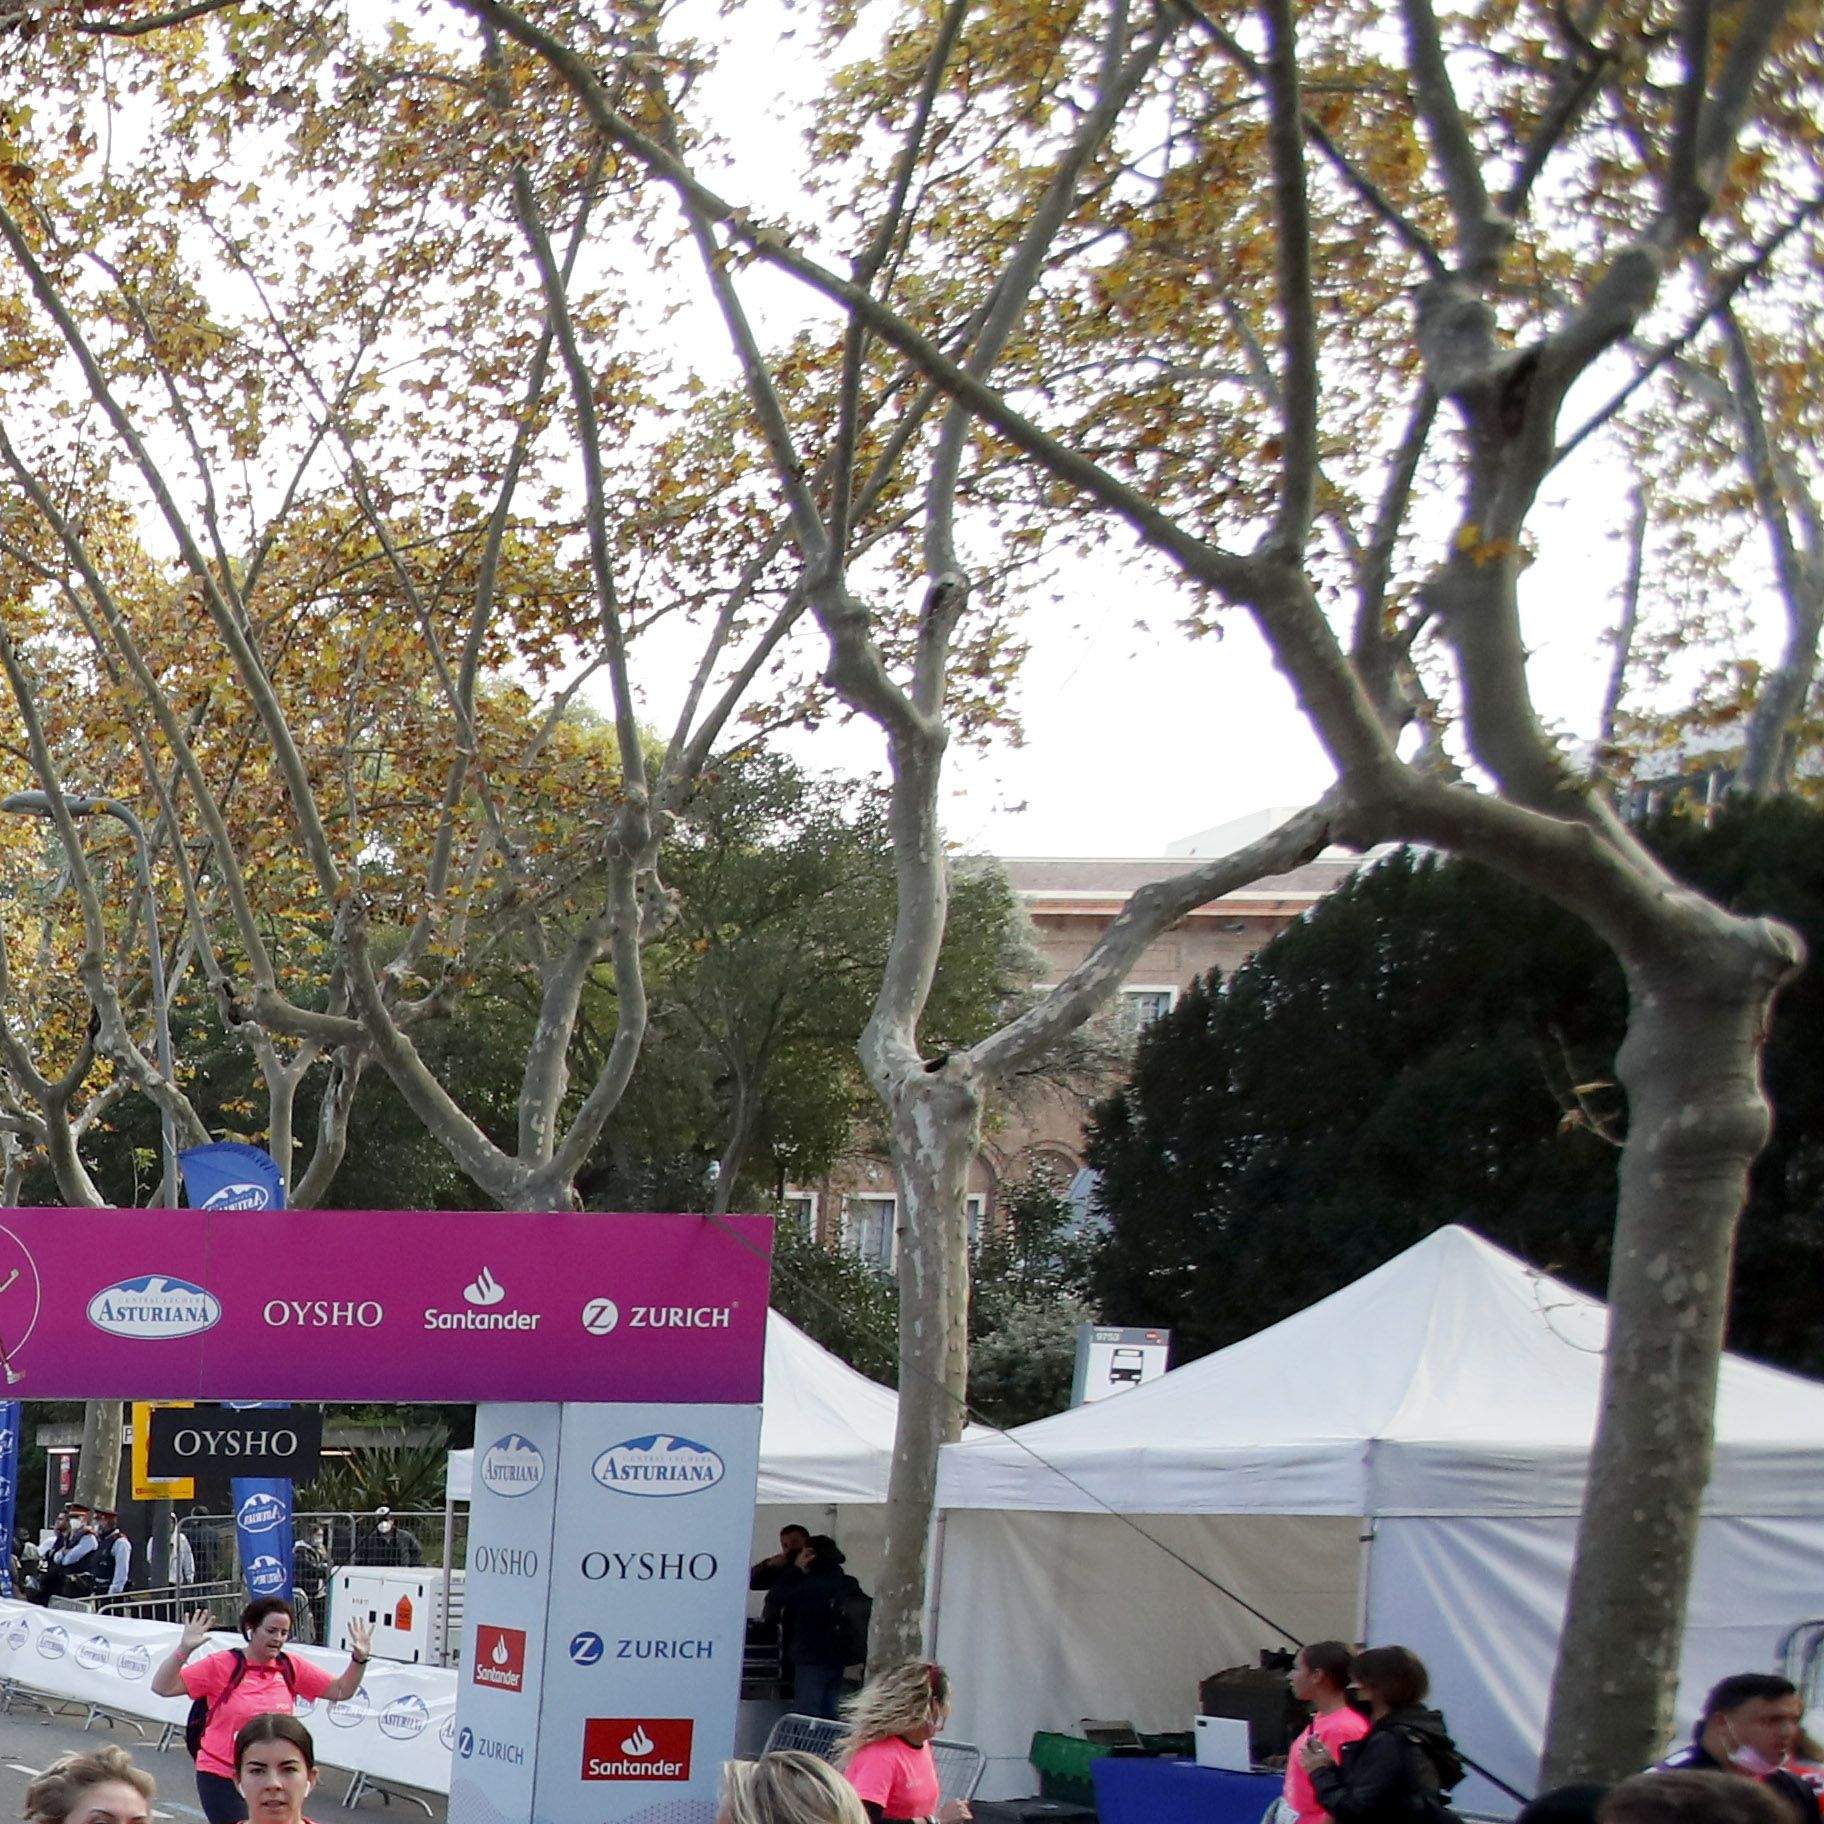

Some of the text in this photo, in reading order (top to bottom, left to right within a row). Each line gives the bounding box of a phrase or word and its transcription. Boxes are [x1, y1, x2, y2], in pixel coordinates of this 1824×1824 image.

[97, 1298, 210, 1323] ASTURIANA
[263, 1299, 384, 1328] OYSHO
[423, 1309, 541, 1331] Santander
[629, 1307, 730, 1328] ZURICH
[173, 1429, 298, 1456] OYSHO
[484, 1458, 540, 1482] ASTURIANA
[602, 1457, 715, 1482] ASTURIANA
[475, 1546, 538, 1578] OYSHO
[581, 1551, 718, 1581] OYSHO
[617, 1640, 713, 1659] ZURICH
[476, 1663, 521, 1686] Santander
[479, 1738, 524, 1765] ZURICH
[588, 1759, 683, 1777] Santander
